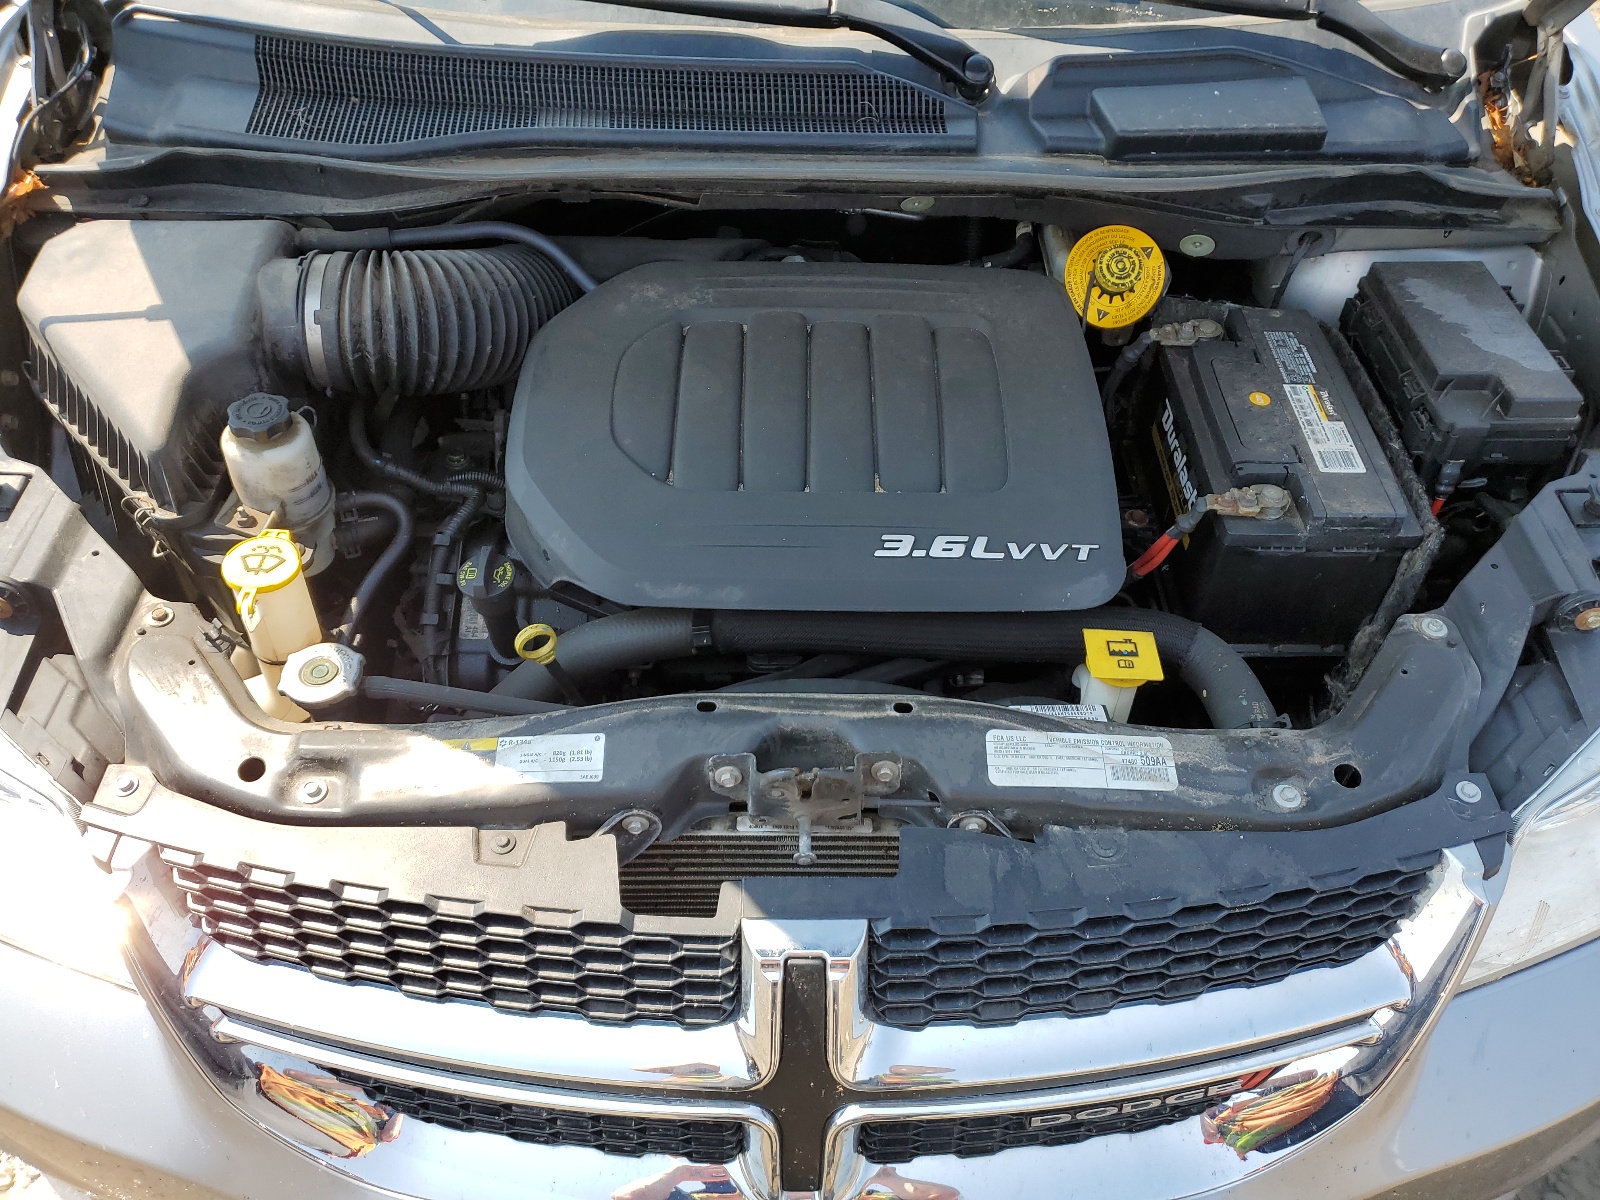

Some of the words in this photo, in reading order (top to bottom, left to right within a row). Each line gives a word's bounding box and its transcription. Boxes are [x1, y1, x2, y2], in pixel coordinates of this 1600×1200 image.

[1162, 398, 1198, 511] Duralast
[874, 534, 1005, 559] 3.6L
[1006, 542, 1100, 562] VVT
[1073, 738, 1100, 746] EMISSION
[1101, 739, 1126, 747] CONTROL
[1140, 755, 1168, 766] 509AA
[1030, 1079, 1244, 1128] DODGE
